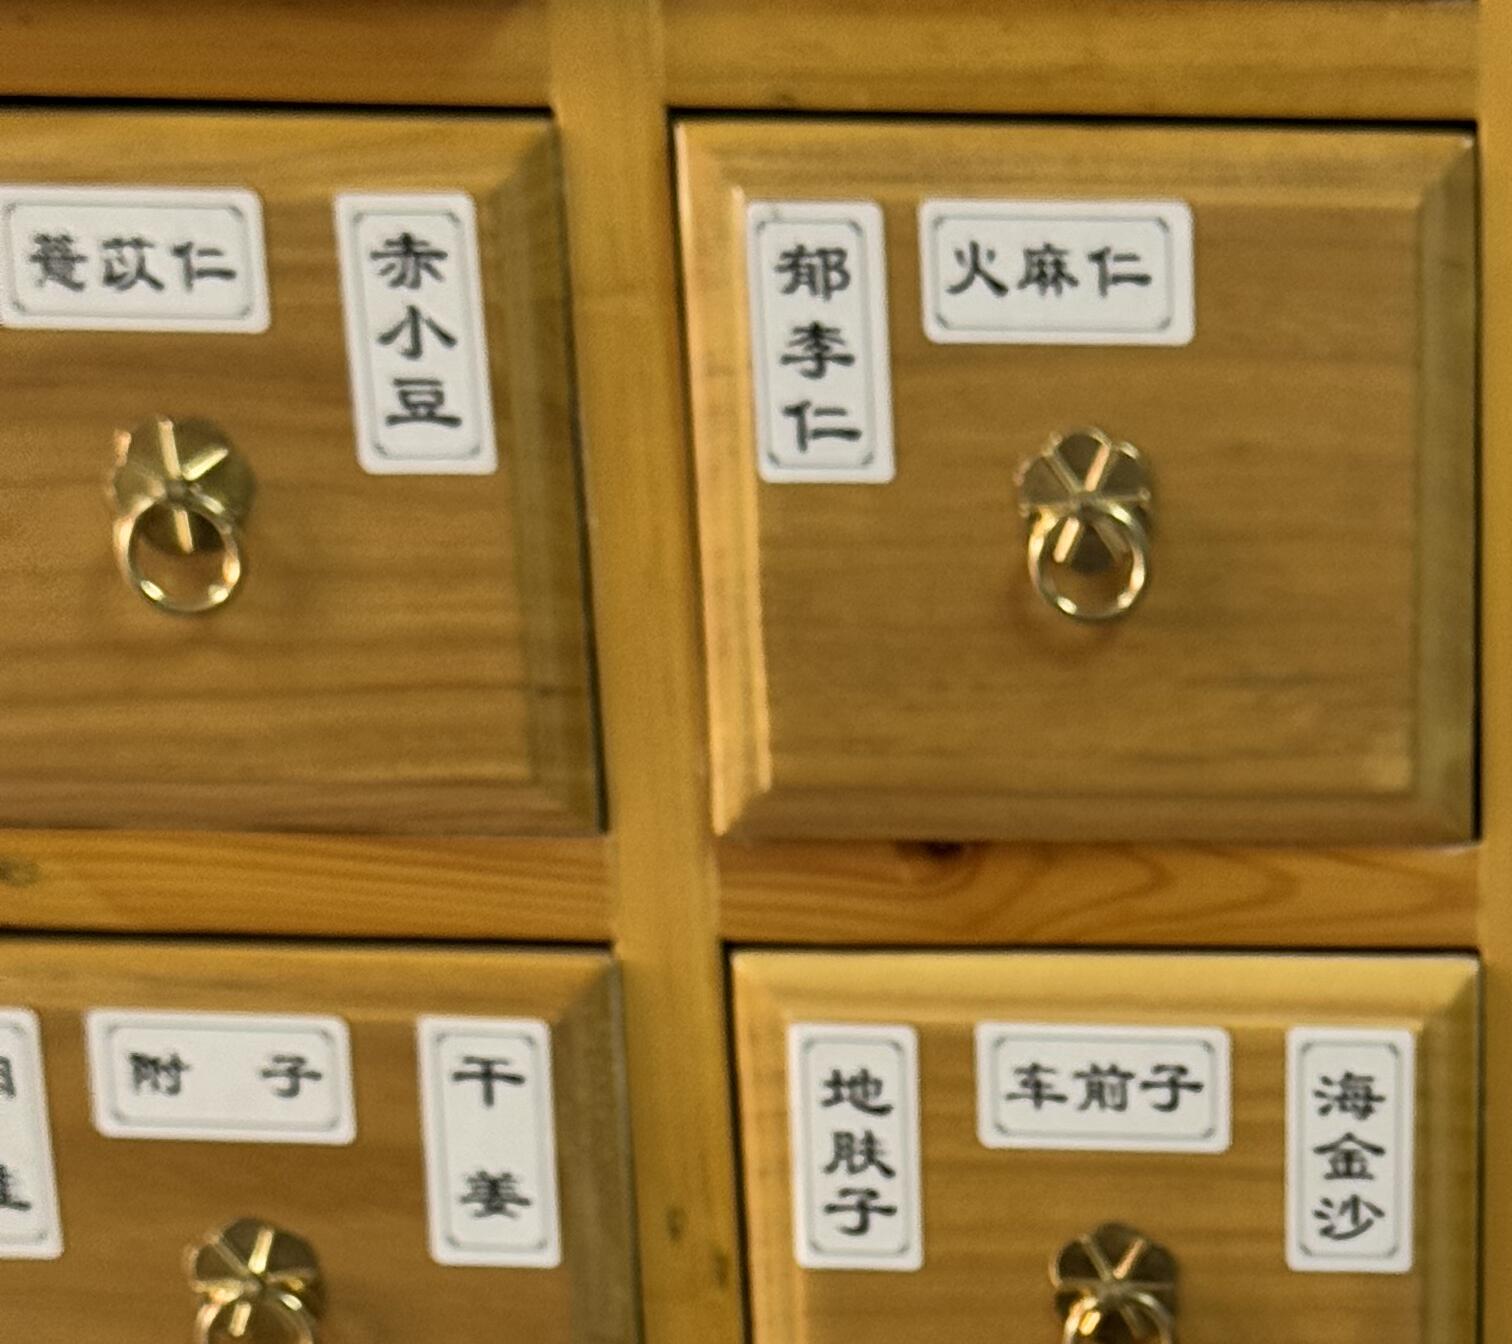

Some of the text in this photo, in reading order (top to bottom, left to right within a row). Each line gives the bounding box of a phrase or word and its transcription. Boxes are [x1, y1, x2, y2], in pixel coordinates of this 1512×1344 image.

[368, 230, 464, 430] 赤小豆
[773, 242, 864, 454] 郁李仁
[945, 239, 1154, 299] 火麻仁
[126, 1050, 324, 1100] 附子
[450, 1054, 533, 1220] 干姜
[819, 1066, 899, 1238] 地肤子
[1004, 1061, 1206, 1114] 车前子
[1311, 1069, 1388, 1243] 海金沙
